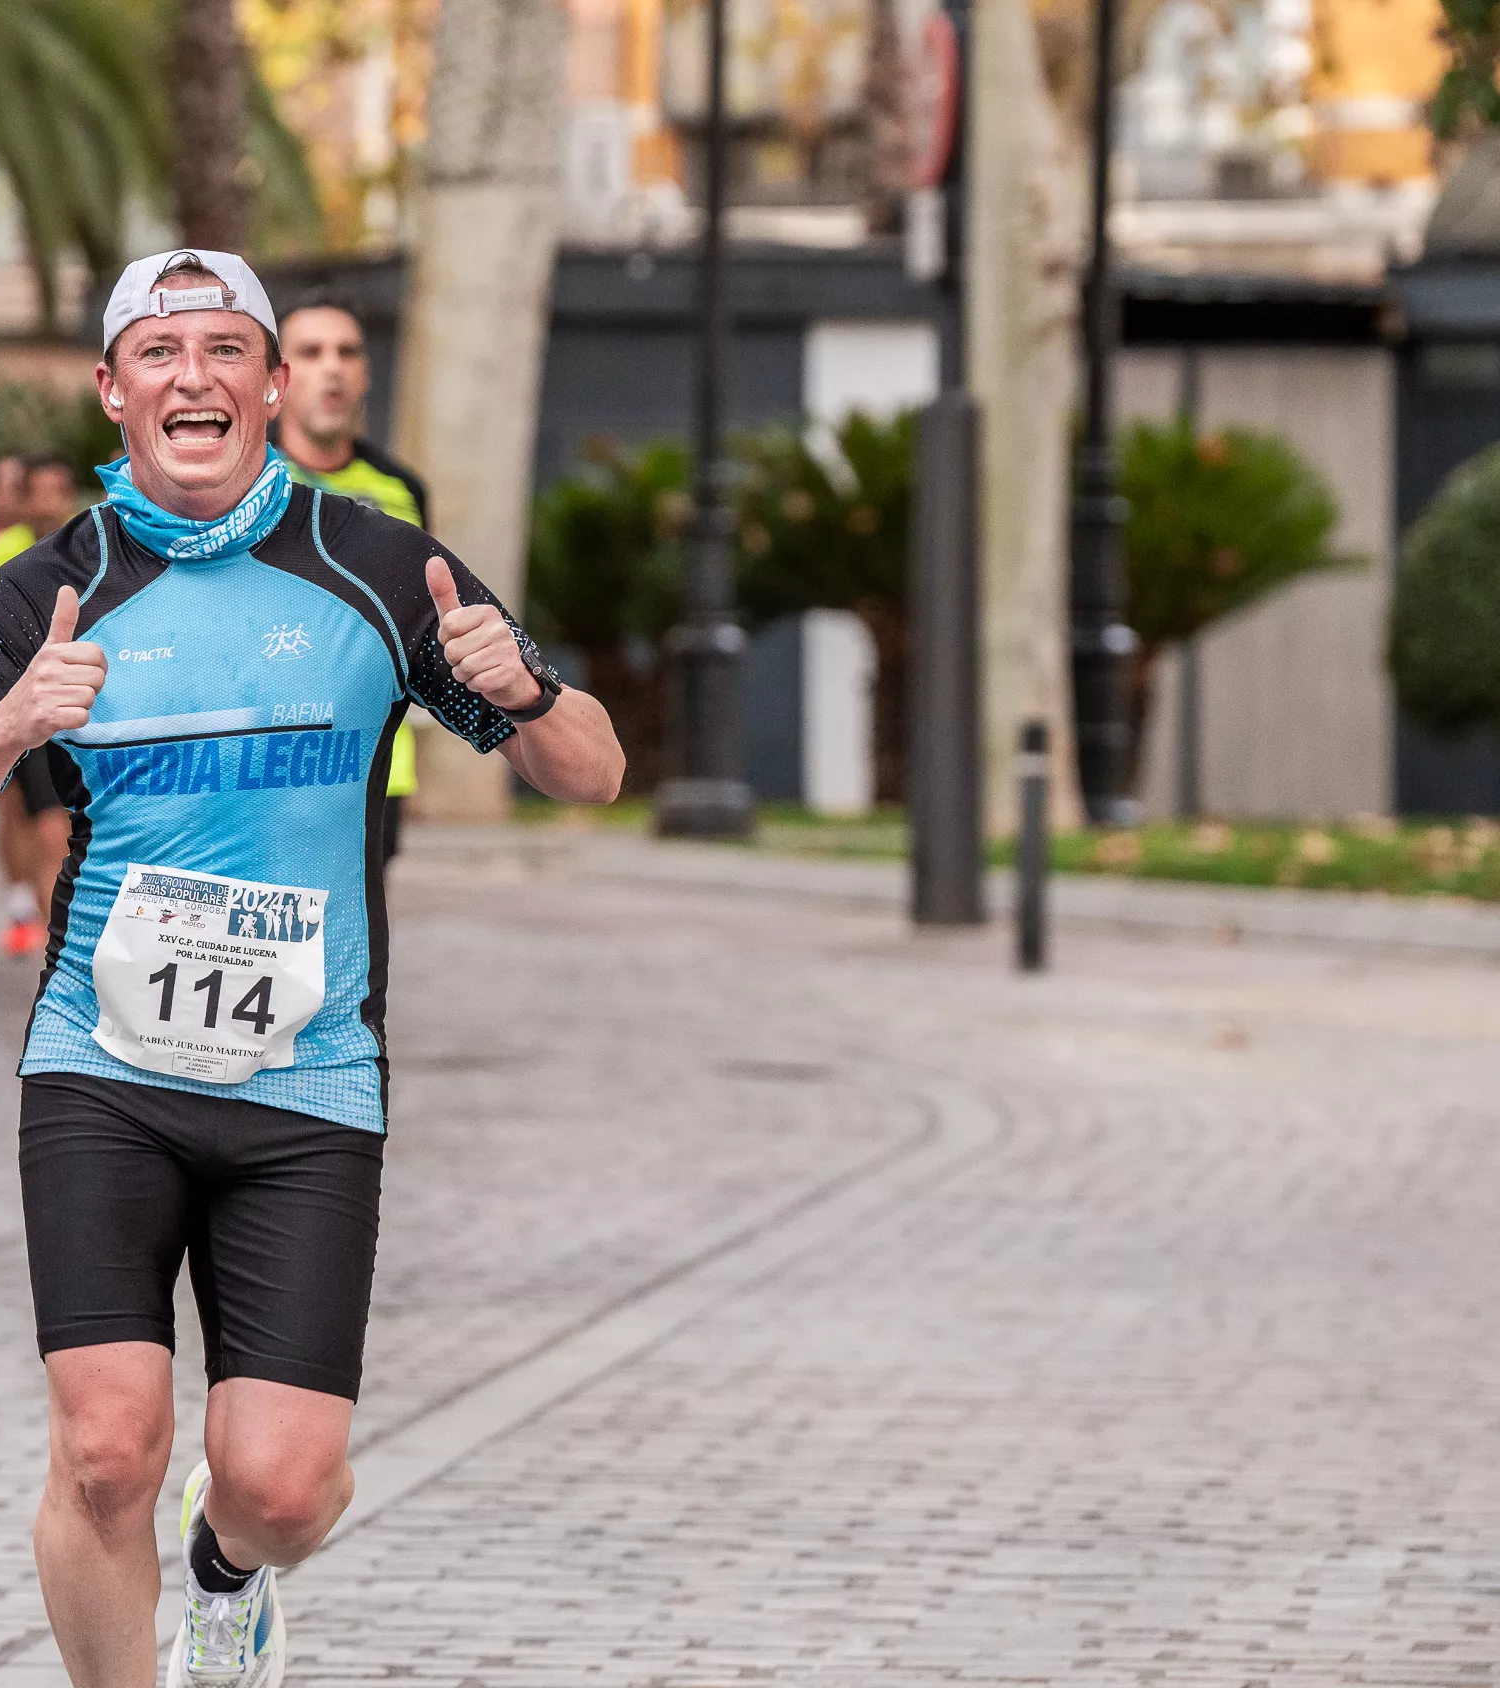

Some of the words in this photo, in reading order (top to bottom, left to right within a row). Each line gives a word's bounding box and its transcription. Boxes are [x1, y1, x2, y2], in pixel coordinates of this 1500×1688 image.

[132, 646, 175, 662] TACTIC
[271, 702, 334, 726] BAENA
[95, 739, 221, 797] MEDIA
[236, 729, 361, 790] LEGUA
[127, 884, 166, 896] RRERAS
[169, 888, 228, 906] POPULARES
[160, 875, 214, 893] PROVINCIAL
[217, 886, 229, 895] DE
[169, 899, 179, 907] DE
[231, 888, 285, 913] 2024
[181, 920, 206, 929] IMDECO
[158, 934, 178, 944] XXV
[178, 938, 194, 947] C.P.
[196, 940, 228, 952] CIUDAD
[230, 945, 241, 954] DE
[243, 947, 277, 959] LUCENA
[175, 949, 192, 959] POR
[194, 952, 206, 961] LA
[208, 954, 254, 967] IGUALDAD
[149, 962, 275, 1035] 114
[139, 1034, 175, 1047] FABIÁN
[175, 1041, 214, 1053] JURADO
[216, 1046, 265, 1058] MARTINEZ
